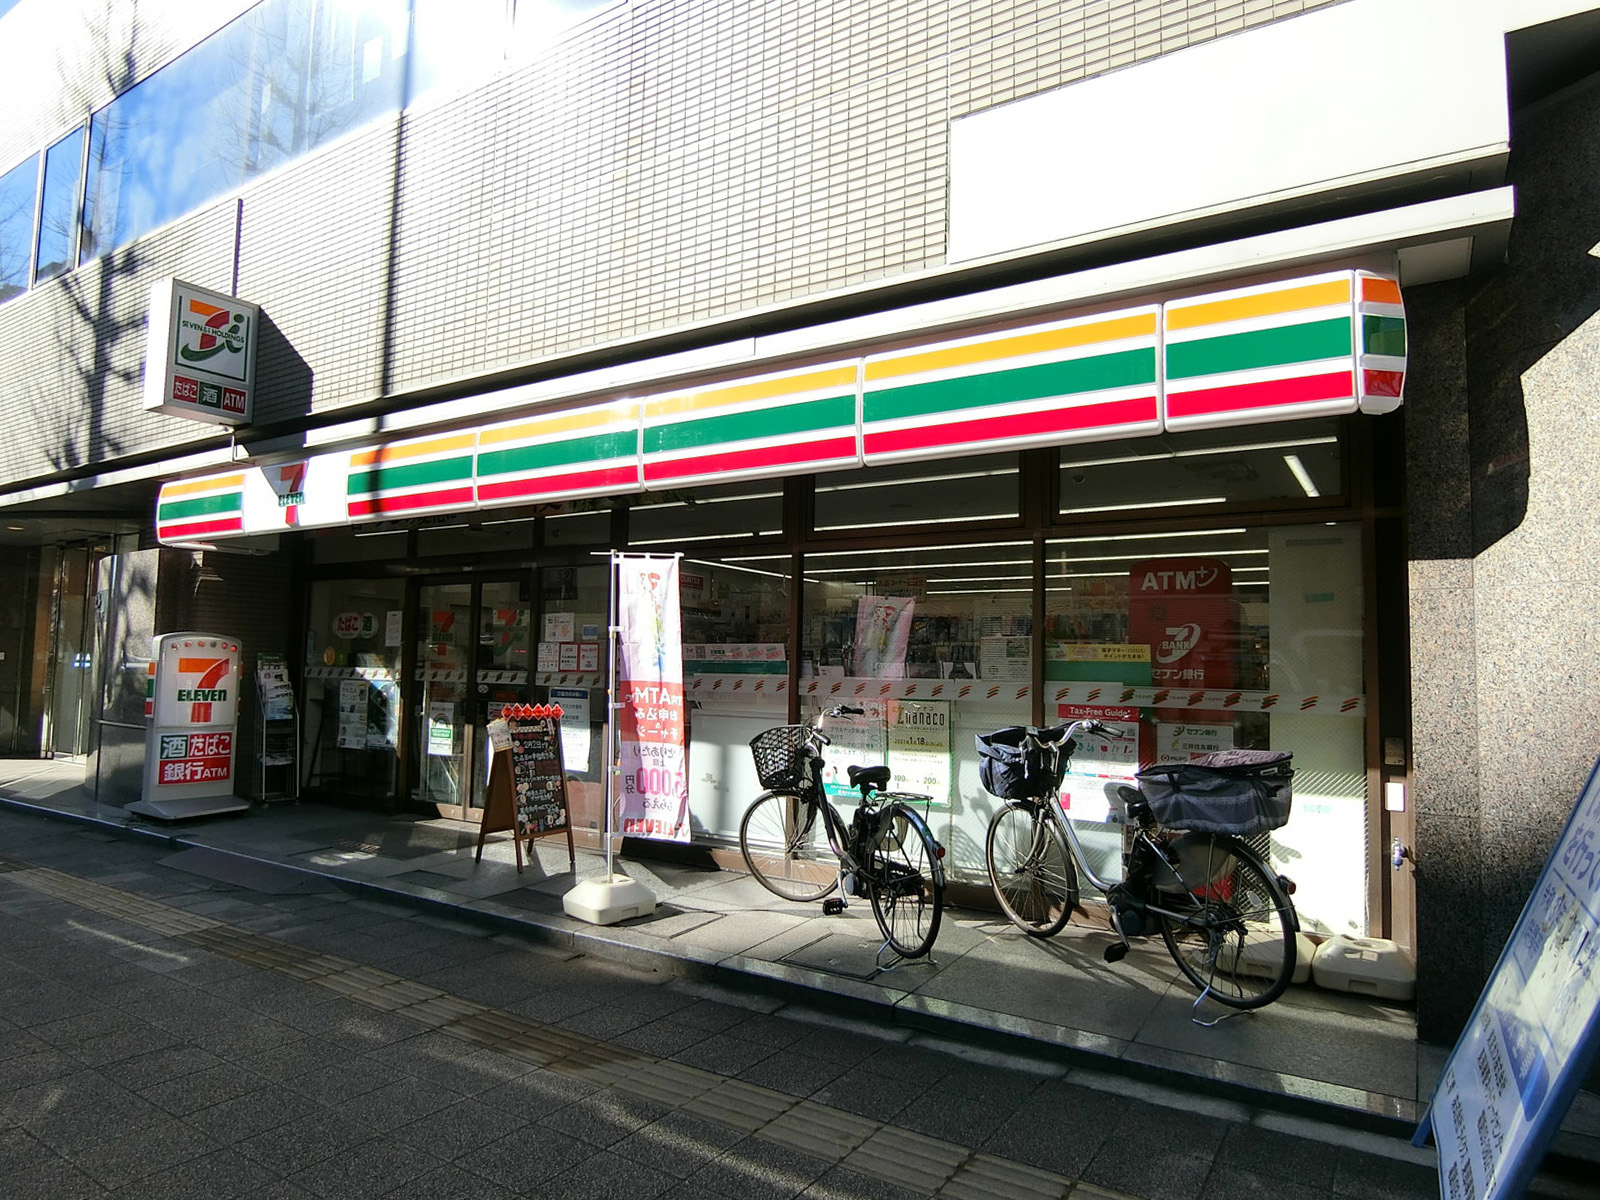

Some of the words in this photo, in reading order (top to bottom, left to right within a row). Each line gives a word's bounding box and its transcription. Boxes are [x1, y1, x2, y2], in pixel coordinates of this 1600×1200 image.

[211, 328, 245, 343] HOLDINGS
[174, 381, 197, 399] たばこ
[202, 387, 218, 403] 酒
[223, 392, 245, 409] ATM
[1141, 571, 1196, 591] ATM
[337, 616, 359, 632] たばこ
[1162, 641, 1191, 651] BANK
[1152, 669, 1205, 681] セブン銀行
[905, 711, 945, 726] nanaco
[1069, 706, 1103, 717] Tax-Free
[1186, 728, 1217, 736] セブン銀行
[162, 736, 187, 758] 酒
[189, 735, 230, 757] たばこ
